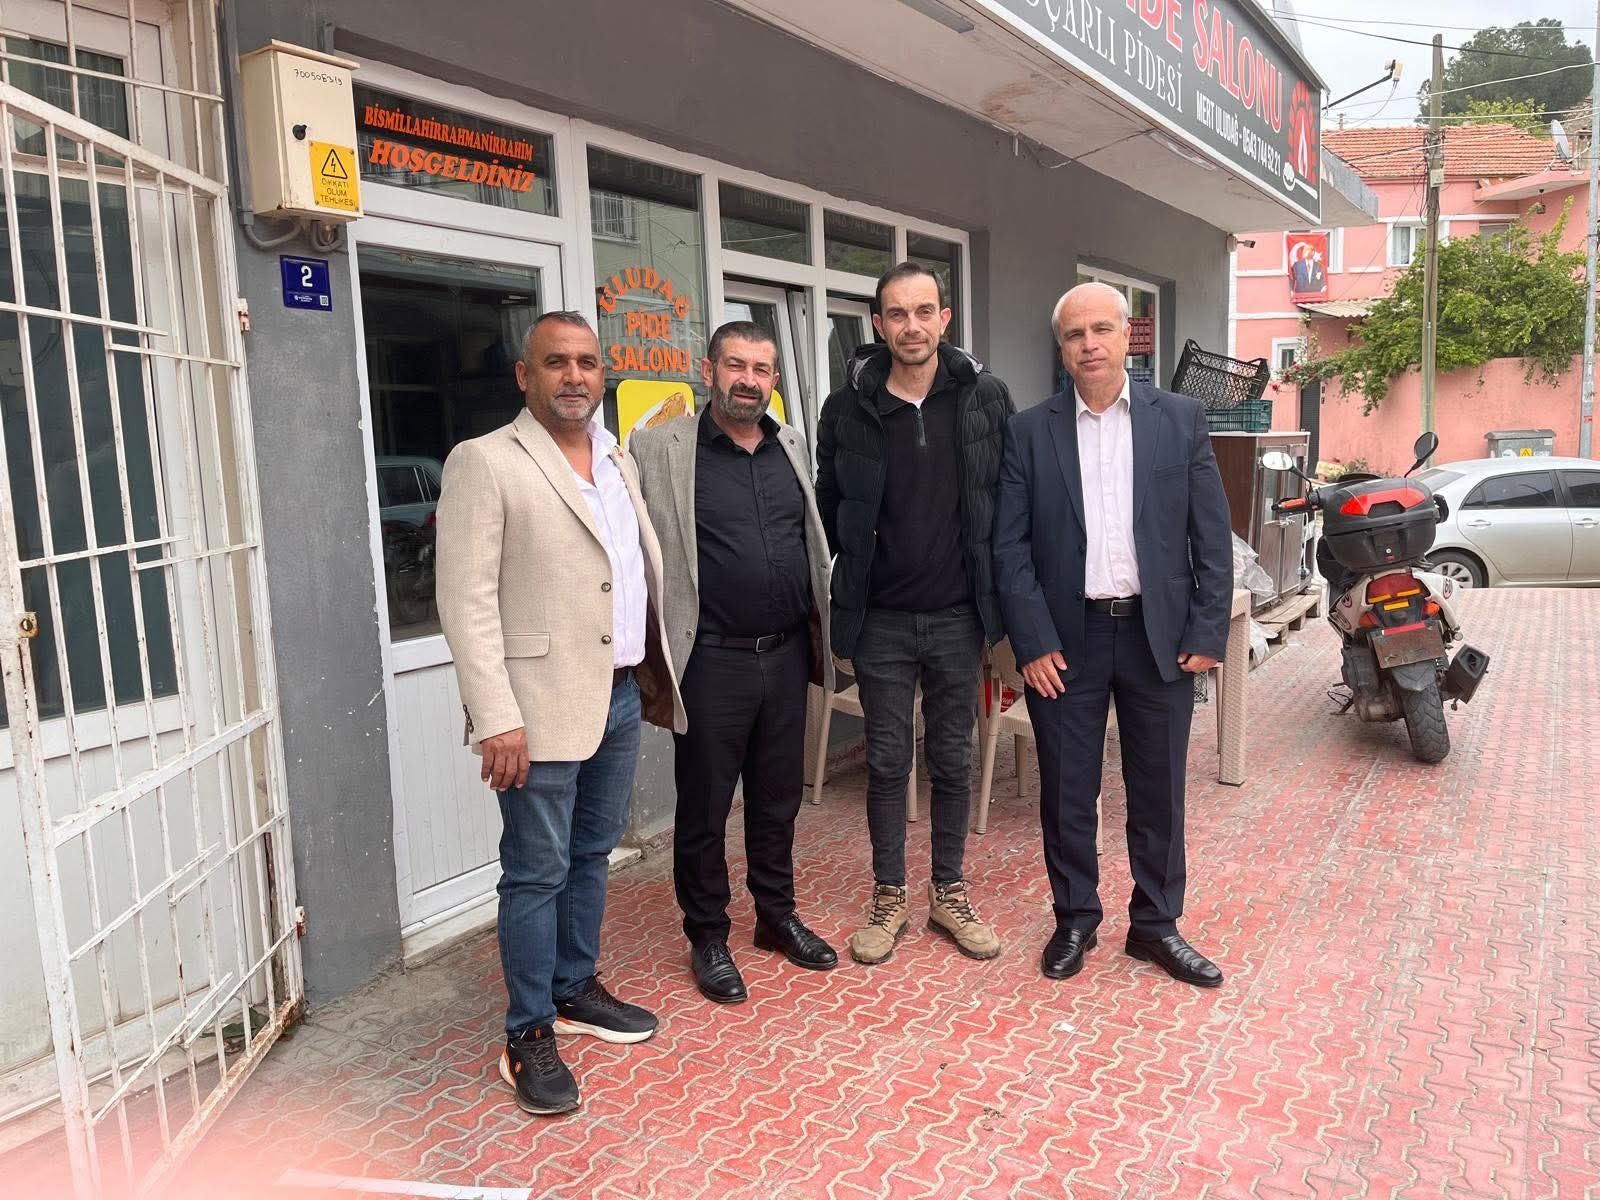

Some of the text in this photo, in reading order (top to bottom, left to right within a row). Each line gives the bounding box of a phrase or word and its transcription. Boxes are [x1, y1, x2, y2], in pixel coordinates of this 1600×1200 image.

[1026, 0, 1116, 65] ÇARLI
[1123, 28, 1183, 113] PİDESİ
[1193, 0, 1282, 133] SALONU
[1196, 90, 1215, 130] MERT
[369, 138, 535, 193] HOŞGELDİNİZ
[301, 265, 313, 287] 2
[627, 307, 672, 339] PİDE
[610, 344, 690, 372] SALONU
